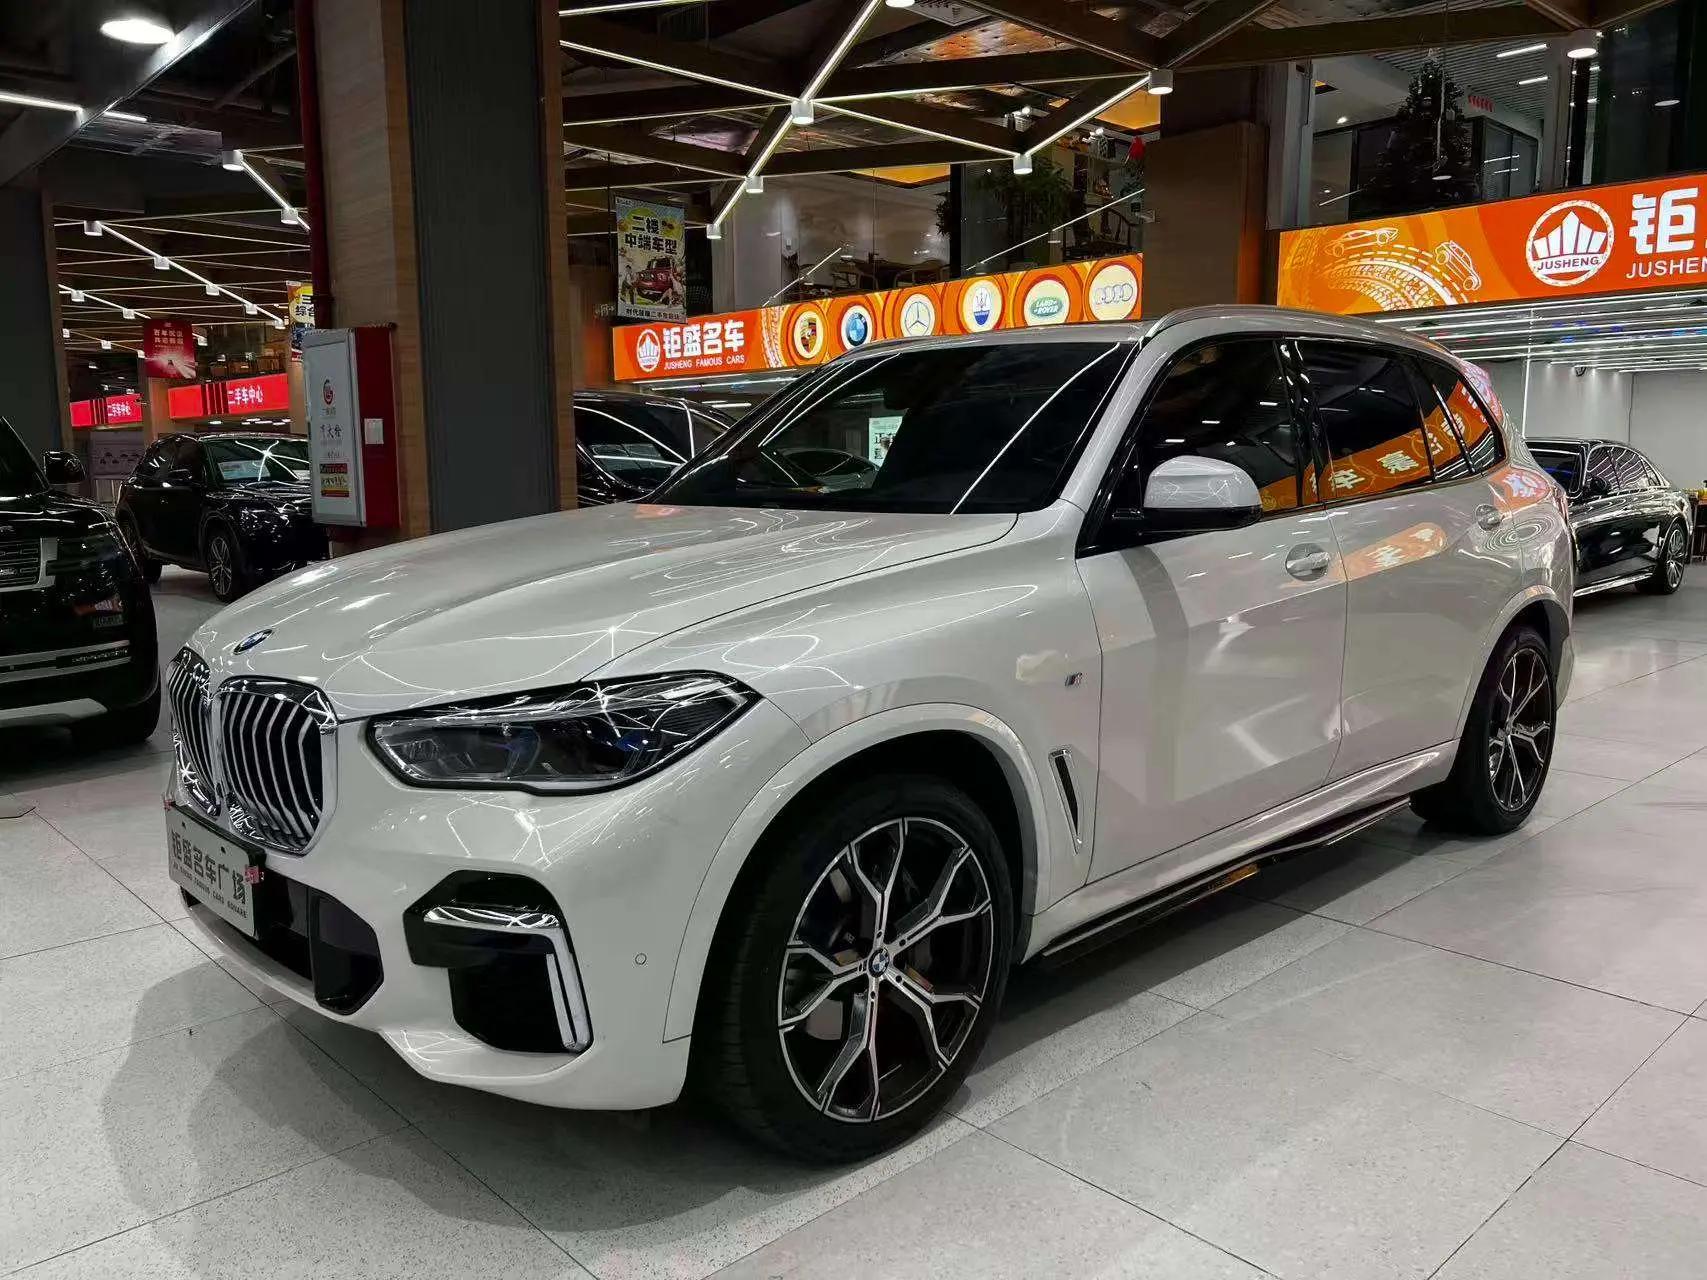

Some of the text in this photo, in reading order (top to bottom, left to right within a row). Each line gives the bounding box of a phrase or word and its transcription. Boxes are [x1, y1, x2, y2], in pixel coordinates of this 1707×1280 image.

[1629, 187, 1707, 255] 钜
[624, 233, 678, 255] 中端车型
[1537, 256, 1600, 271] JUSHENG
[662, 320, 745, 359] 钜盛名车
[664, 359, 693, 370] JUSHENG
[695, 357, 723, 368] FAMOUS
[725, 354, 745, 365] CARS
[228, 385, 264, 407] 二手车中心
[107, 401, 132, 417] 二手车中心
